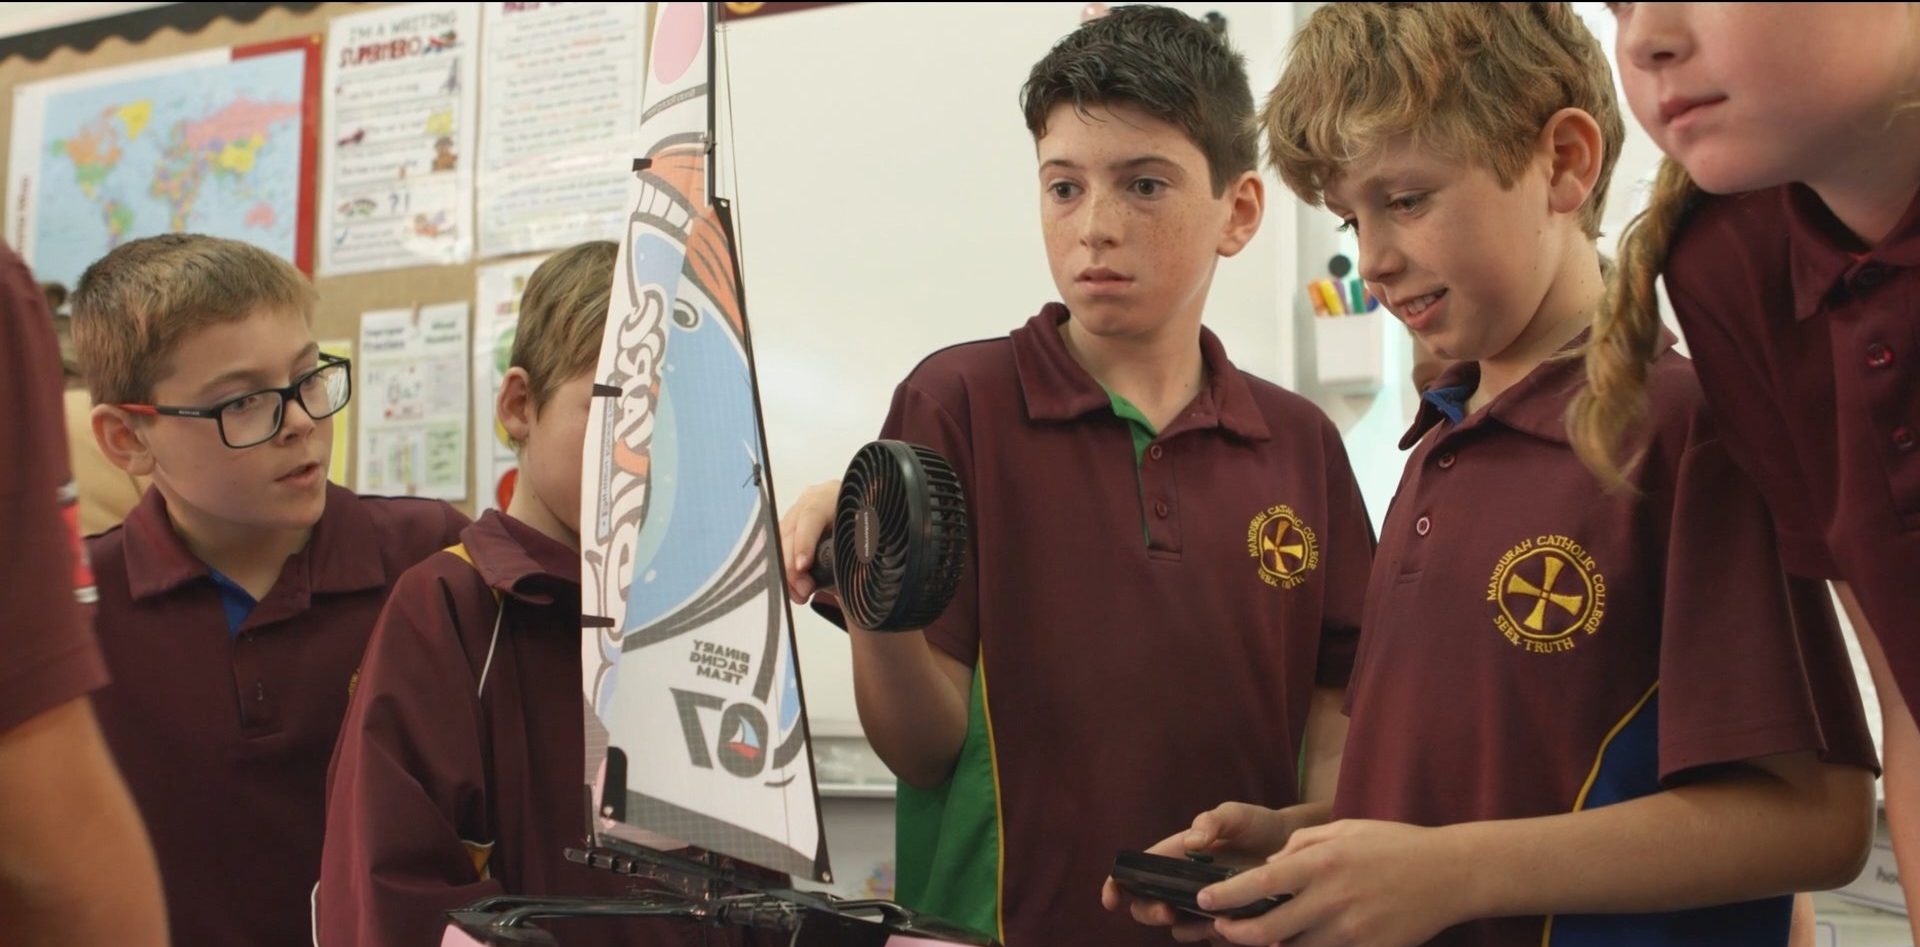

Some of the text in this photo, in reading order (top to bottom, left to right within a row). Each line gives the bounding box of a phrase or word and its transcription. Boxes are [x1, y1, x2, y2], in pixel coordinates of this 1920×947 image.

[339, 35, 422, 68] SUPERHERO
[1303, 526, 1319, 571] COLLEGE
[1487, 535, 1606, 635] MANDURAH CATHOLIC COLLEGE
[1493, 615, 1575, 653] SEEK TRUTH
